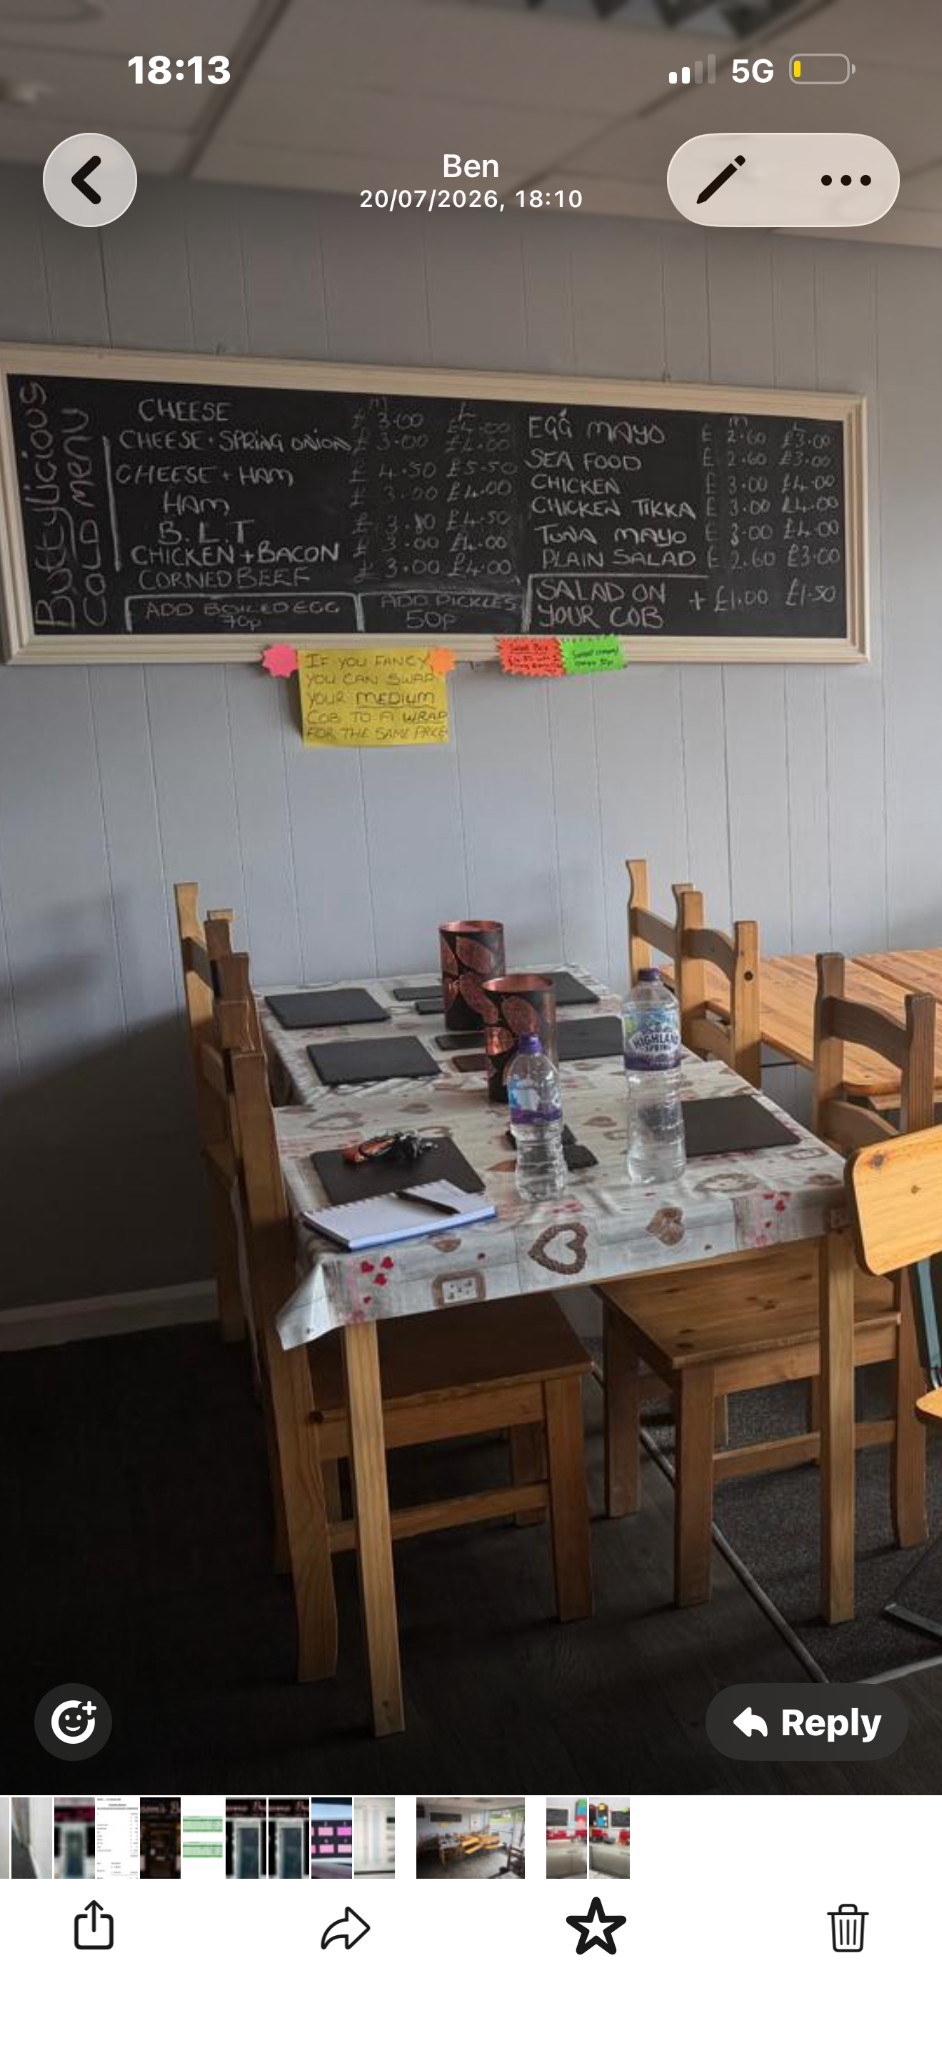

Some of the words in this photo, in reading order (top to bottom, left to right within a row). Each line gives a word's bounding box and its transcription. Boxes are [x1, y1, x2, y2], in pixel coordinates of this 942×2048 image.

[137, 398, 233, 422] CHEESE
[119, 429, 207, 450] CHEESE
[527, 411, 574, 441] EGG
[726, 429, 768, 446] 2.60
[523, 447, 575, 472] SEA
[582, 451, 643, 472] FOOD
[726, 449, 769, 466] 2.60
[115, 463, 218, 485] CHEESE
[530, 473, 622, 496] CHICKEN
[727, 475, 769, 496] 3.00
[529, 496, 621, 518] CHICKEN
[631, 498, 697, 520] TIKKA
[727, 498, 772, 517] 3.00
[729, 522, 775, 547] 3.00
[129, 543, 235, 566] CHICKEN
[541, 547, 604, 570] PLAIN
[610, 548, 697, 568] SALAD
[729, 547, 777, 570] 2.60
[786, 542, 841, 568] £3.00
[138, 569, 233, 591] CORNED
[236, 566, 312, 590] BEEF
[385, 557, 441, 579] 3.00
[380, 594, 428, 610] ADD
[435, 594, 517, 611] PICKLES
[535, 579, 626, 603] SALAD
[630, 580, 667, 605] ON
[712, 584, 770, 613] £1.00
[784, 576, 838, 607] £1.50
[145, 601, 195, 619] ADD
[291, 601, 342, 615] EGG
[536, 604, 601, 629] YOUR
[608, 604, 665, 630] COB
[304, 652, 329, 669] IF
[340, 655, 368, 671] YOU
[375, 653, 430, 669] FANCY
[306, 672, 337, 687] YOU
[342, 671, 379, 686] CAN
[306, 690, 342, 708] YOUR
[306, 710, 340, 724] COB
[348, 710, 372, 723] TO
[379, 710, 395, 722] A
[401, 710, 449, 723] WRAP
[339, 727, 370, 740] THE
